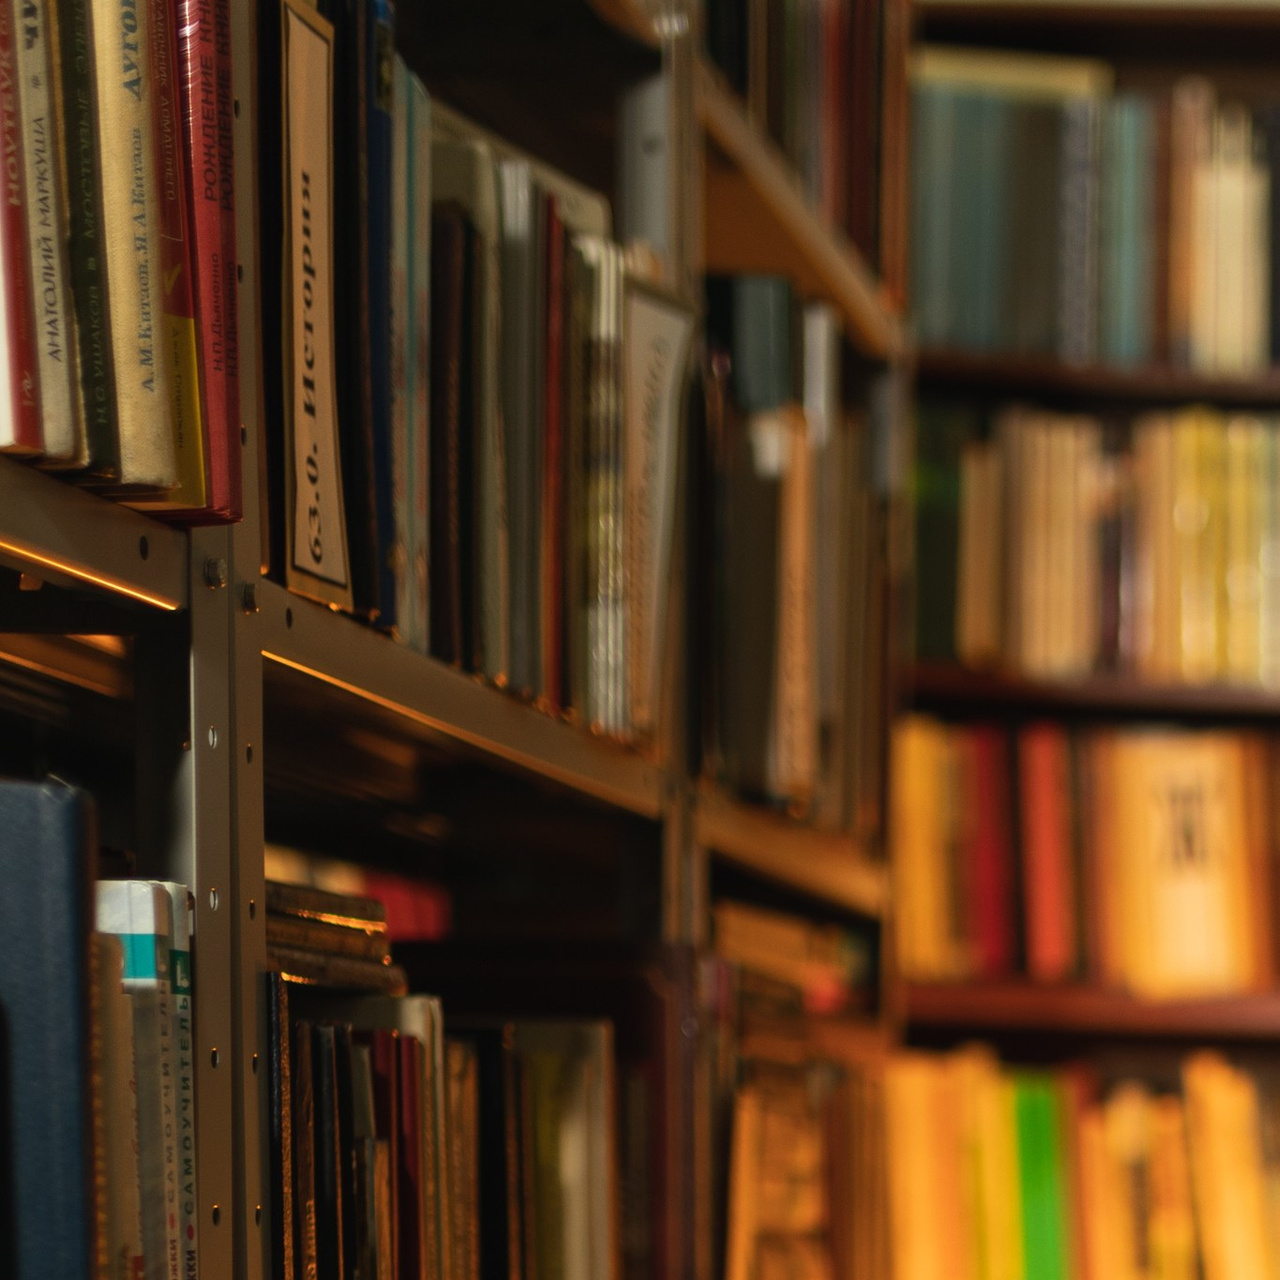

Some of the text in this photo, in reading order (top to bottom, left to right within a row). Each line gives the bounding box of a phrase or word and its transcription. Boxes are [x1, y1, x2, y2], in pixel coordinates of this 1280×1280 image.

[199, 55, 219, 202] РОЖДЕНИЕ
[214, 65, 234, 212] РОЖДЕНИЕ
[32, 117, 61, 362] АНАТОЛИЙ МАРКУША
[300, 170, 323, 566] 63.0. История
[178, 996, 195, 1216] САМОУЧИТЕЛЬ
